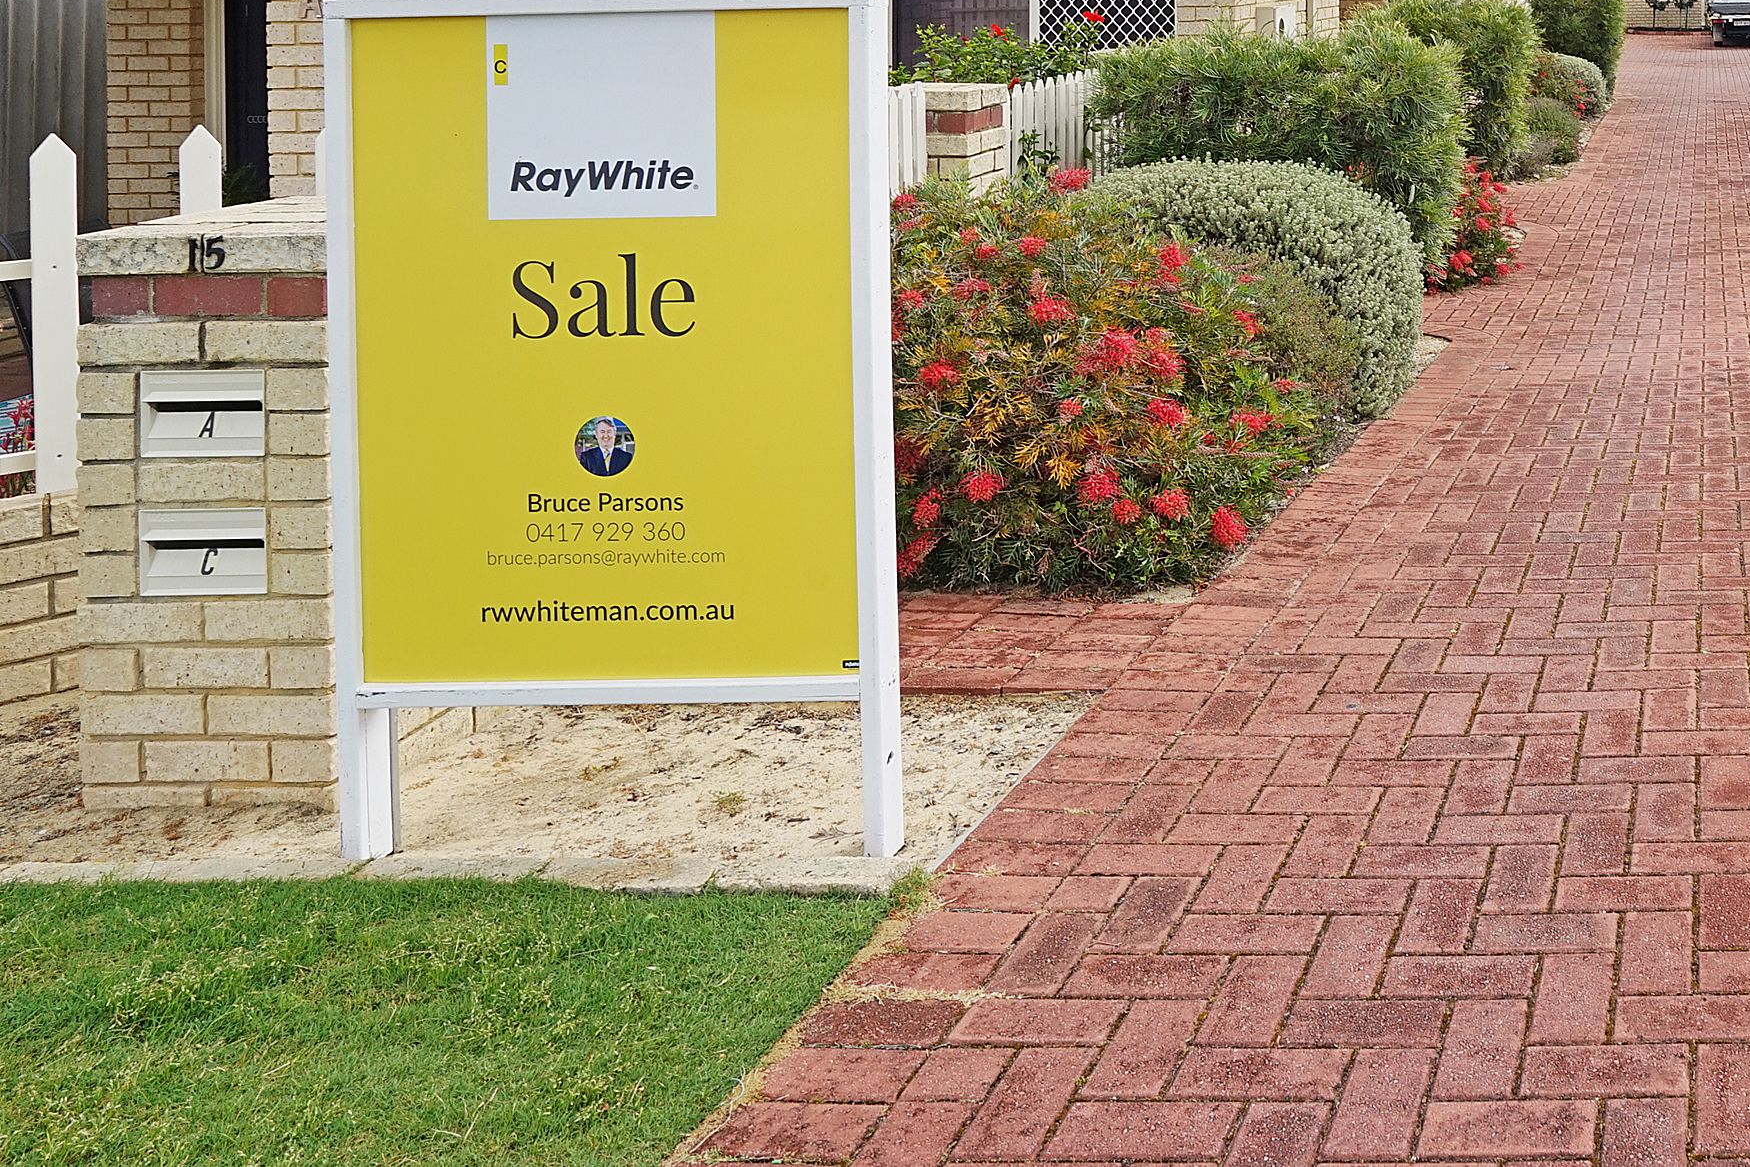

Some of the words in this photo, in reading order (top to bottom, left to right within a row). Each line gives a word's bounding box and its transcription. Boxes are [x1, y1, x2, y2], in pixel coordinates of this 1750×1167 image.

[494, 60, 507, 74] C
[187, 235, 226, 272] 15
[512, 252, 696, 340] Sale
[198, 411, 216, 439] A
[527, 493, 591, 513] Bruce
[598, 492, 684, 513] Parsons
[526, 522, 584, 542] 0417
[592, 522, 634, 542] 929
[643, 521, 686, 541] 360
[200, 548, 219, 576] C
[487, 548, 726, 569] bruce.parsons@raywhite.com
[481, 600, 735, 623] rwwhiteman.com.au
